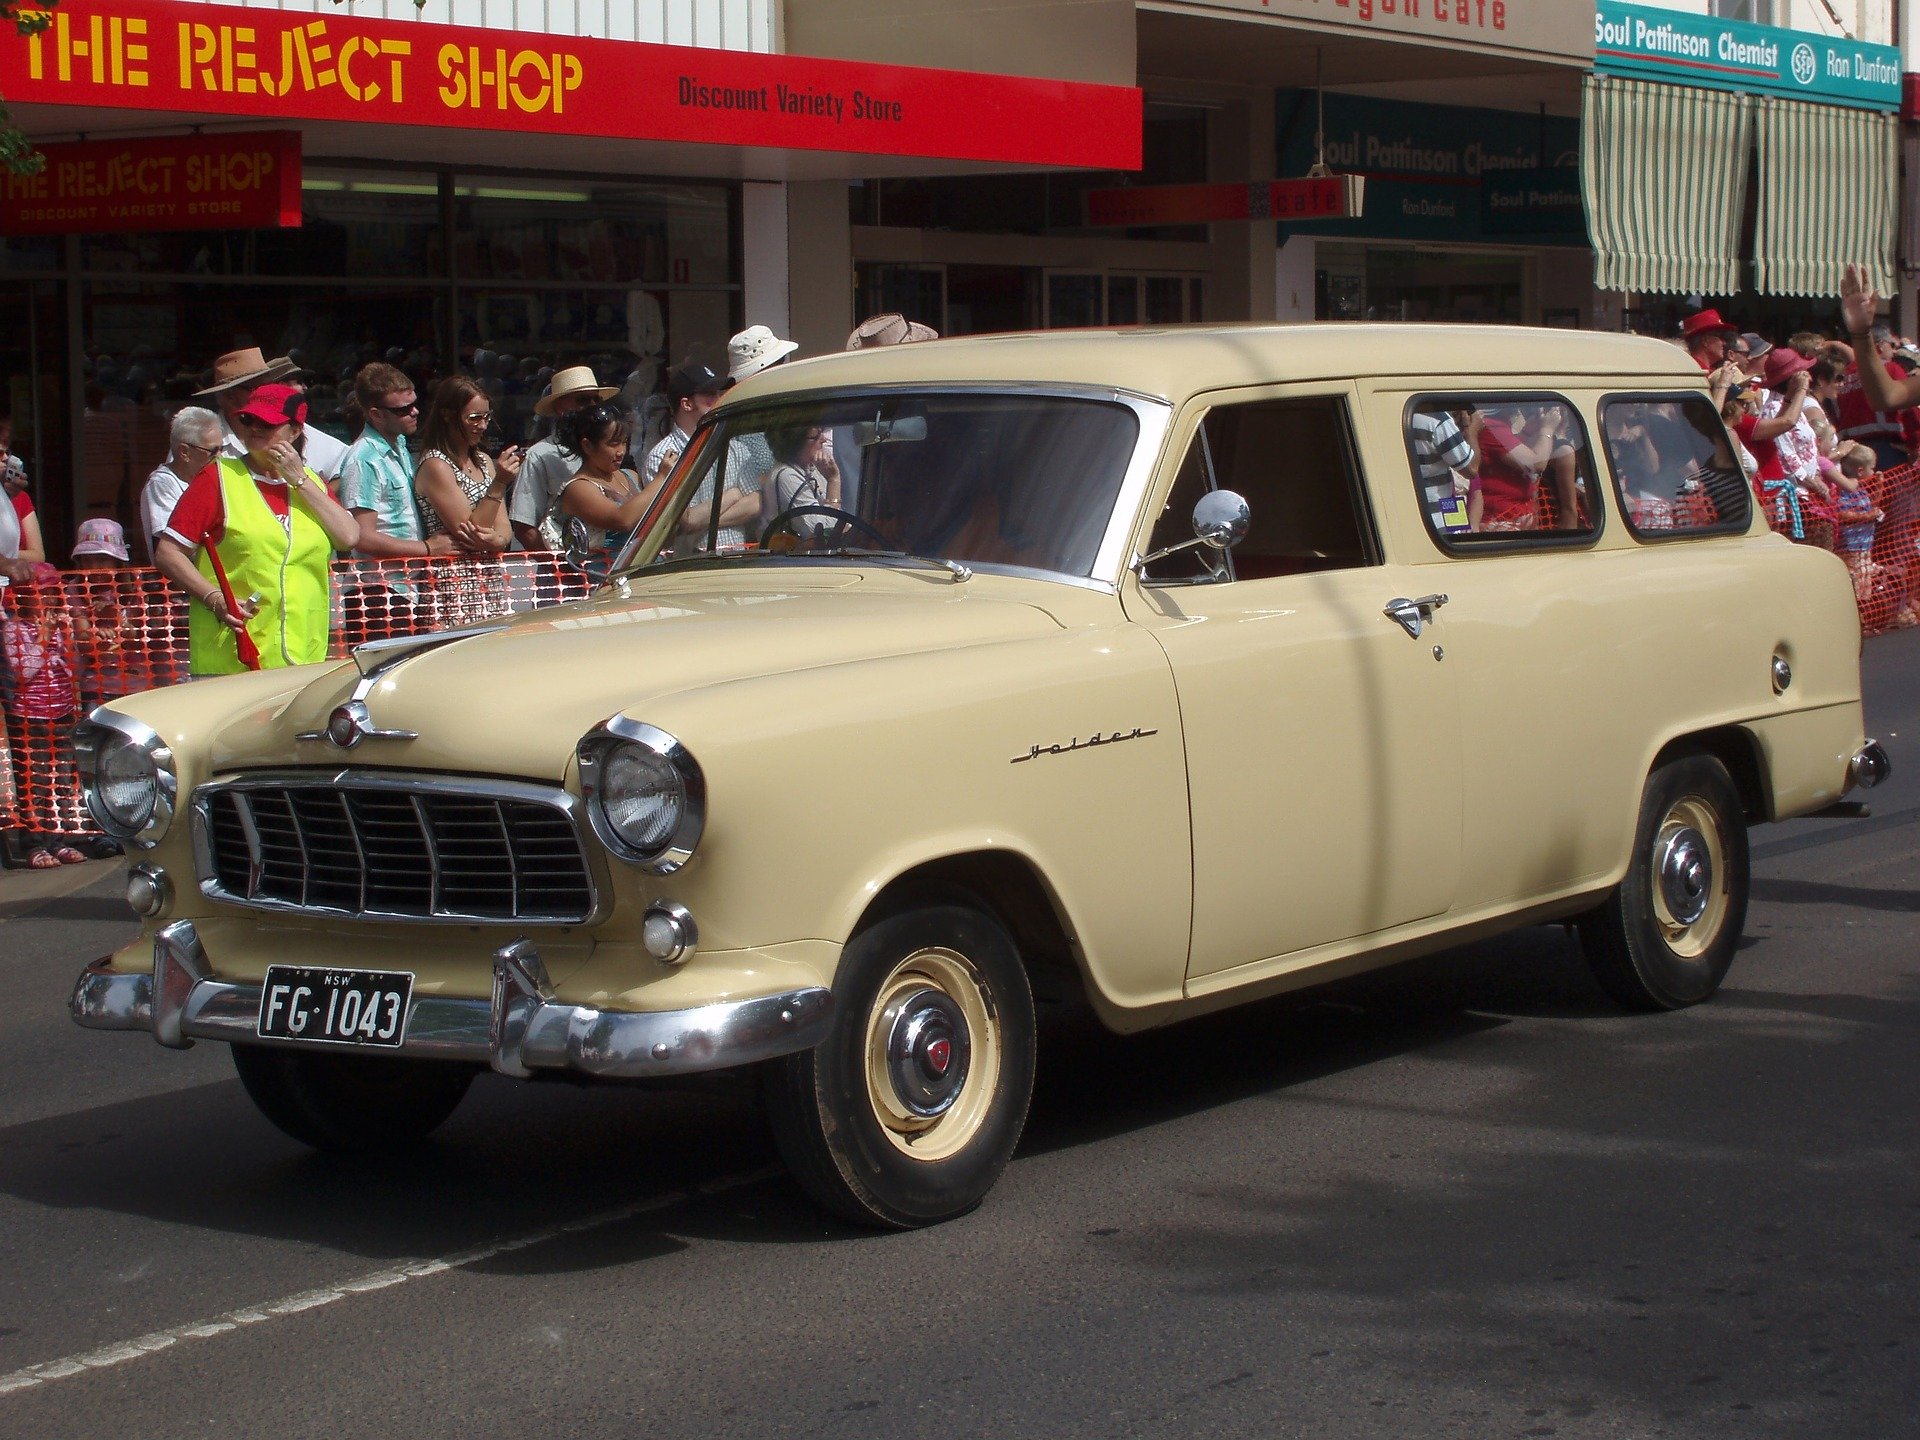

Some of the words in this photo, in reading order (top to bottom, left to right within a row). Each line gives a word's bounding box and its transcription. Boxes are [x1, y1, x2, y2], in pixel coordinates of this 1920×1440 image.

[1594, 13, 1630, 46] Soul
[1636, 20, 1709, 58] Pattinson
[1718, 32, 1778, 68] Chemist
[17, 9, 149, 87] THE
[179, 20, 411, 103] REJECT
[438, 43, 583, 114] SHOP
[1826, 49, 1850, 78] Ron
[1854, 53, 1898, 85] Dunford
[678, 75, 768, 112] Discount
[776, 84, 845, 124] Variety
[853, 91, 903, 122] Store
[1366, 135, 1458, 174] Pattinson
[58, 151, 176, 198] REJECT
[186, 151, 274, 193] SHOP
[20, 206, 98, 221] DISCOUNT
[108, 203, 176, 218] VARIETY
[188, 200, 242, 215] STORE
[1402, 197, 1420, 215] Ron
[1420, 198, 1456, 217] Dunford
[1490, 190, 1523, 207] Soul
[324, 975, 352, 987] NSW
